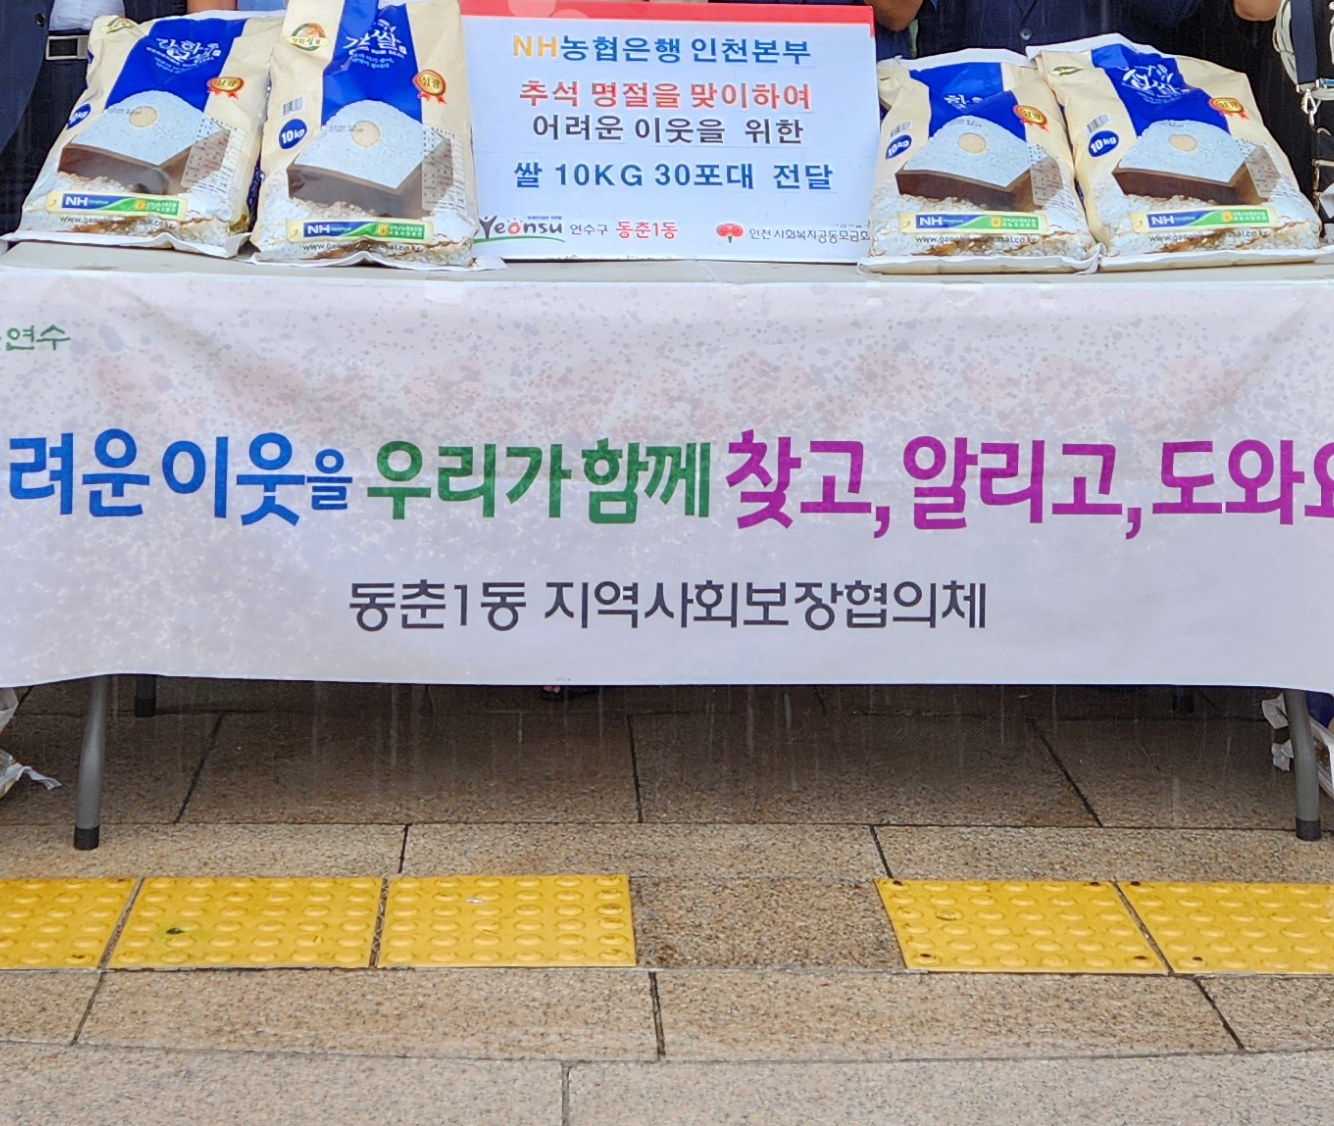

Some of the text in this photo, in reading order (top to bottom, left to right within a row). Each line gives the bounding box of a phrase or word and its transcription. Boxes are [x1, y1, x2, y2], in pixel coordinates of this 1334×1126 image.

[512, 34, 812, 65] NH농협은행 인천본부
[518, 79, 812, 110] 추석 명절을 맞이하여
[532, 113, 805, 145] 어려운 이웃을 위한
[1090, 139, 1118, 155] 10kg
[513, 160, 834, 191] 쌀 10KG 30포대 전달
[65, 195, 89, 207] NH
[307, 223, 331, 234] NH
[615, 220, 679, 240] 동춘1동
[919, 216, 943, 226] NH
[1151, 215, 1175, 225] NH
[748, 228, 772, 241] 인천
[162, 429, 353, 527] 이웃을
[367, 439, 571, 520] 우리가
[580, 434, 711, 525] 함께
[725, 429, 892, 540] 찾고,
[903, 437, 1143, 540] 알리고,
[349, 578, 988, 632] 동춘1동 지역사회보장협의체
